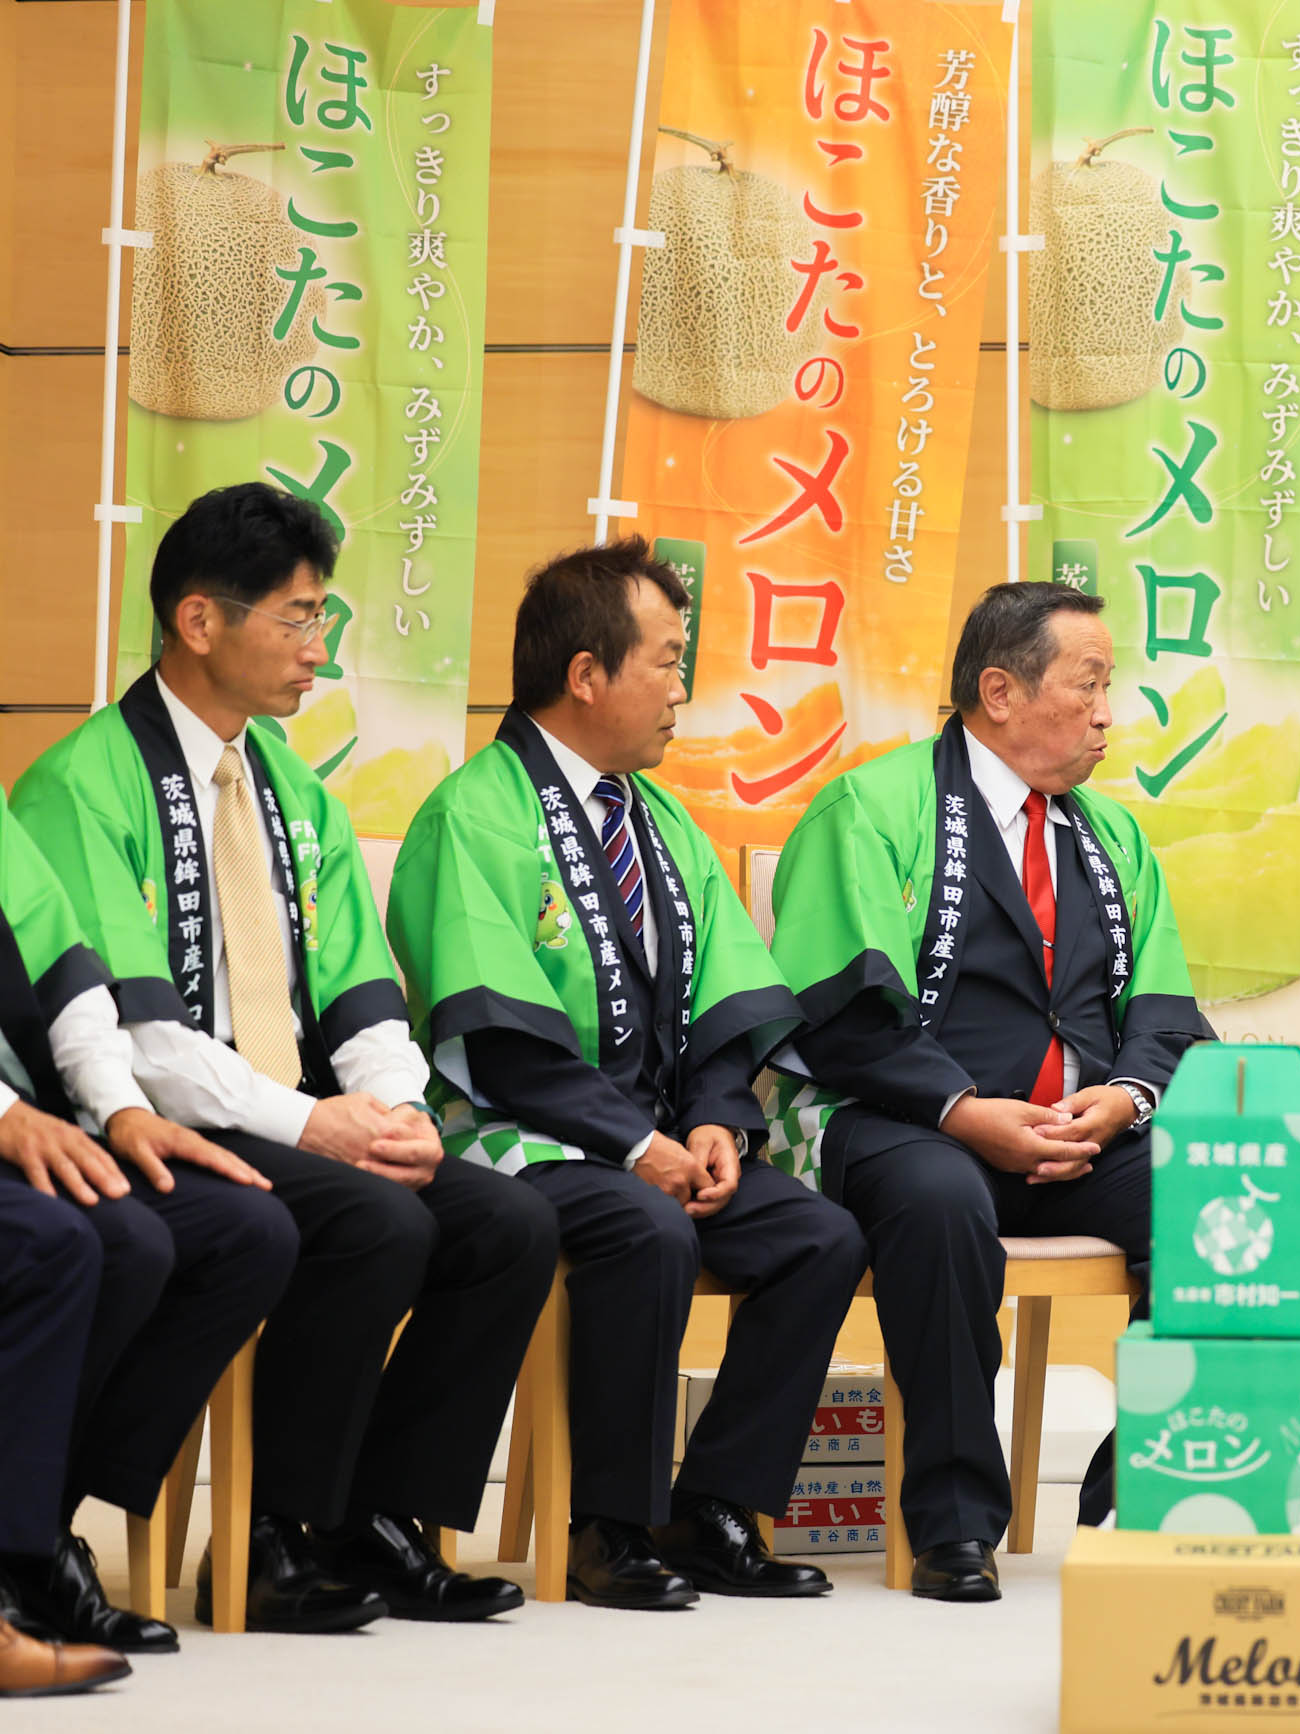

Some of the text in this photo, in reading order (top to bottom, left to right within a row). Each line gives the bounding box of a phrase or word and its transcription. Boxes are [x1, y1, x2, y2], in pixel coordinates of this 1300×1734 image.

[394, 62, 452, 637] すっきり爽やか、みずみずしい
[732, 28, 891, 805] ほこたのメロン
[882, 49, 976, 585] 芳醇な香りと、とろける甘さ
[1125, 20, 1236, 798] ほこたのメロン
[540, 785, 633, 1045] 茨城県鉾田市産メロン
[1130, 1428, 1262, 1472] メロン
[1167, 1405, 1249, 1432] ほこたの
